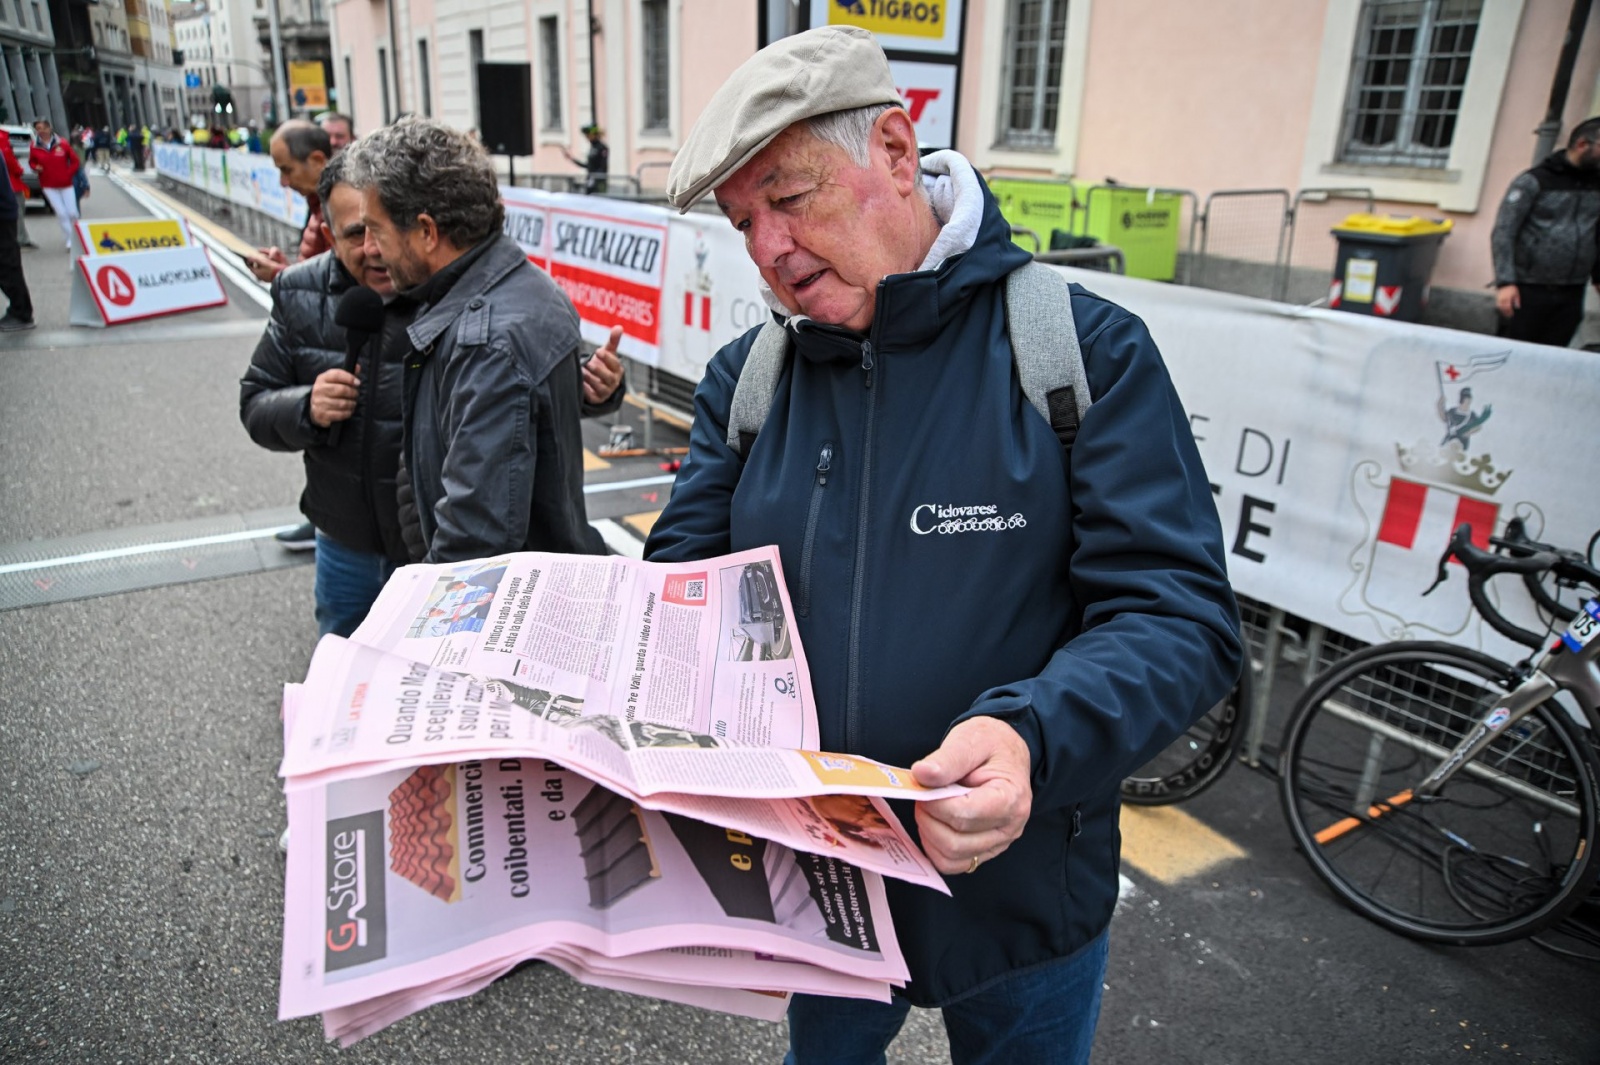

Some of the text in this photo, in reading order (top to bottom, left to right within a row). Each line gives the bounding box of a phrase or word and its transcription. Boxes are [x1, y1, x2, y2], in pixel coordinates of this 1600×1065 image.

[869, 0, 940, 23] TIGROS
[898, 89, 941, 123] T
[125, 235, 181, 250] TIGROS
[553, 220, 660, 274] SPECIALIZED
[730, 297, 769, 329] CO
[1234, 427, 1291, 485] DI
[503, 577, 522, 601] Legnano
[522, 568, 542, 595] Nazionale
[497, 606, 510, 620] nato
[516, 595, 532, 610] della
[511, 611, 526, 625] culla
[504, 632, 518, 648] stata
[639, 625, 650, 642] video
[634, 648, 647, 671] guarda
[630, 673, 642, 690] Valli:
[627, 692, 638, 703] Tre
[385, 690, 421, 745] Quando
[456, 705, 481, 731] suoi
[489, 719, 513, 739] per
[714, 720, 728, 738] utto
[540, 759, 567, 822] e da p
[499, 779, 530, 899] coibentati.
[729, 853, 752, 871] e
[813, 871, 826, 886] srl
[326, 831, 358, 951] G Store
[833, 893, 853, 938] Gemonio
